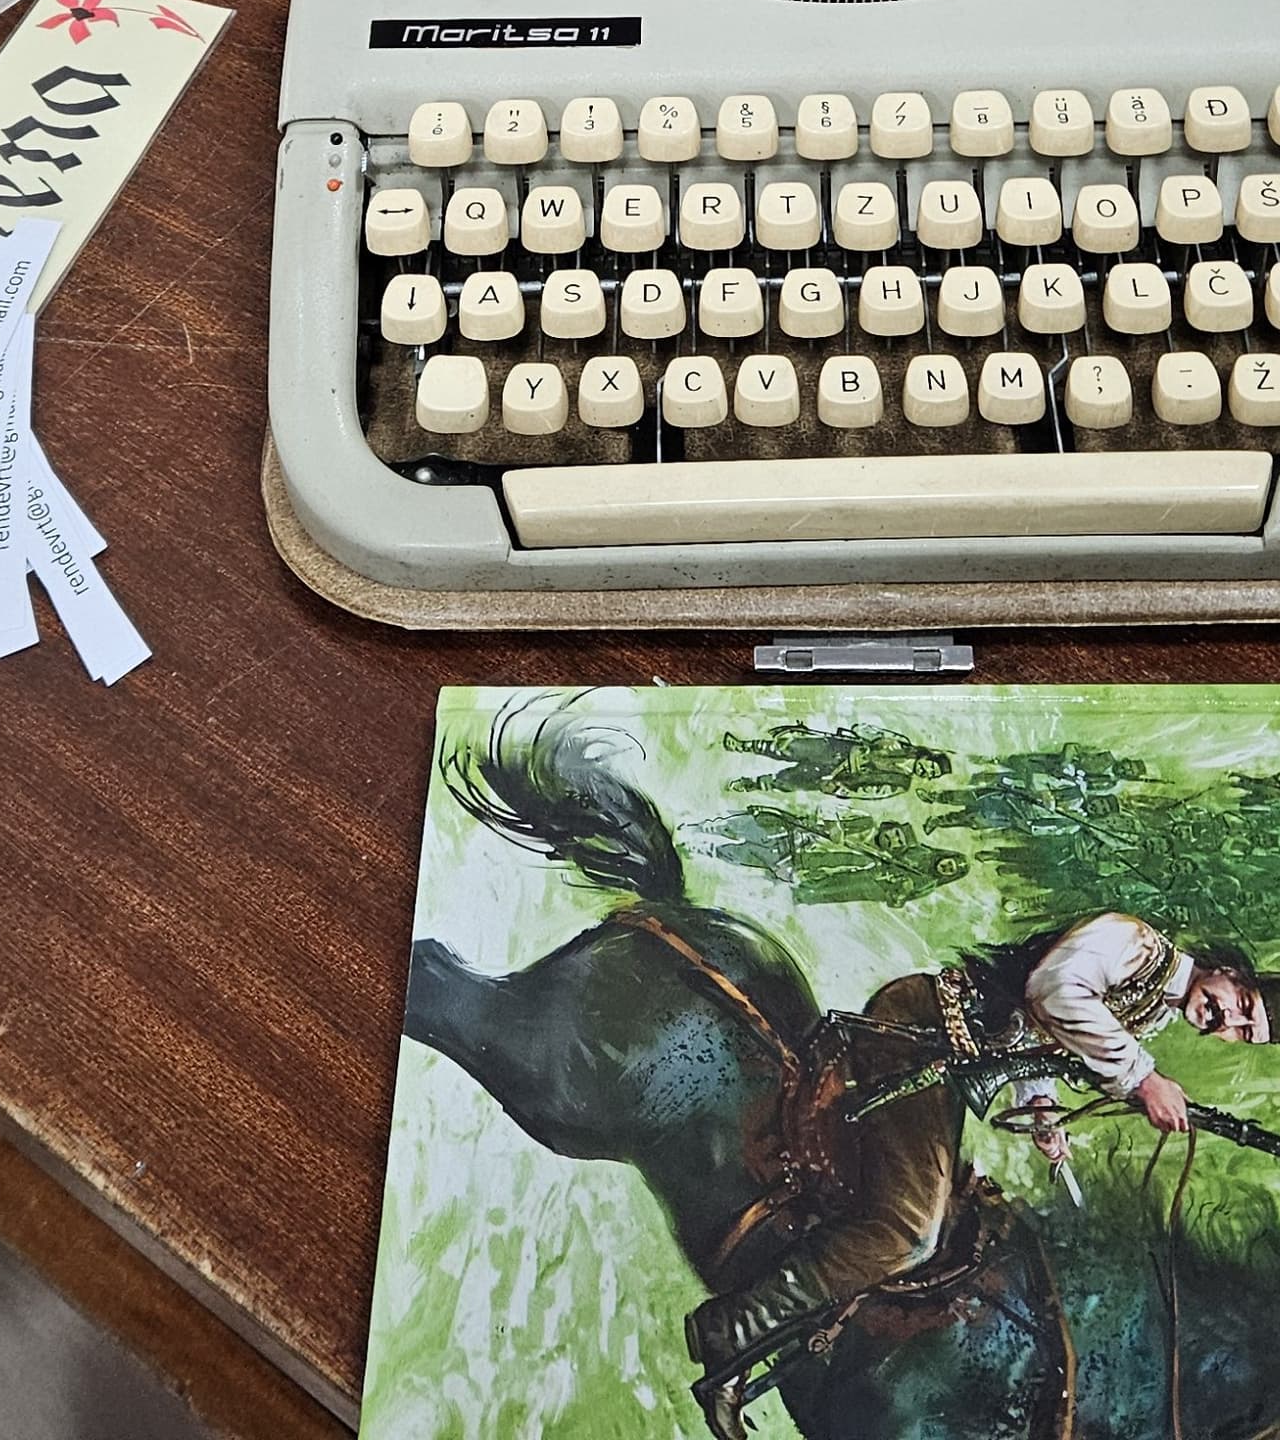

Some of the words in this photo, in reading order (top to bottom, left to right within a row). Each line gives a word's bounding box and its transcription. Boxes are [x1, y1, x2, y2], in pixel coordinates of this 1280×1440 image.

[401, 22, 580, 44] Maritsa
[589, 27, 611, 42] 11
[506, 120, 519, 133] 2
[583, 119, 595, 131] 3
[661, 118, 676, 130] 4
[741, 117, 754, 129] 5
[820, 116, 832, 128] 6
[895, 114, 907, 127] 7
[977, 112, 989, 125] 8
[1056, 111, 1070, 125] 9
[1204, 99, 1229, 117] Đ
[465, 201, 486, 221] Q
[538, 198, 565, 218] W
[624, 197, 641, 217] E
[702, 194, 722, 215] R
[779, 195, 797, 215] T
[856, 194, 875, 216] Z
[939, 193, 960, 214] U
[1026, 191, 1033, 211] I
[1095, 198, 1118, 219] O
[1181, 188, 1202, 208] P
[1260, 180, 1280, 208] Š
[477, 284, 501, 305] A
[563, 283, 582, 304] S
[642, 283, 662, 304] D
[721, 281, 740, 303] F
[800, 282, 822, 303] G
[881, 279, 902, 301] H
[963, 280, 980, 302] J
[1042, 276, 1064, 298] K
[1131, 277, 1150, 298] L
[1208, 267, 1230, 296] Č
[525, 377, 544, 401] Y
[599, 369, 621, 392] X
[684, 370, 703, 392] C
[757, 369, 776, 391] V
[840, 370, 861, 393] B
[926, 368, 947, 393] N
[1000, 366, 1024, 389] M
[1252, 360, 1276, 391] Ž
[25, 479, 91, 598] rendevrt@g
